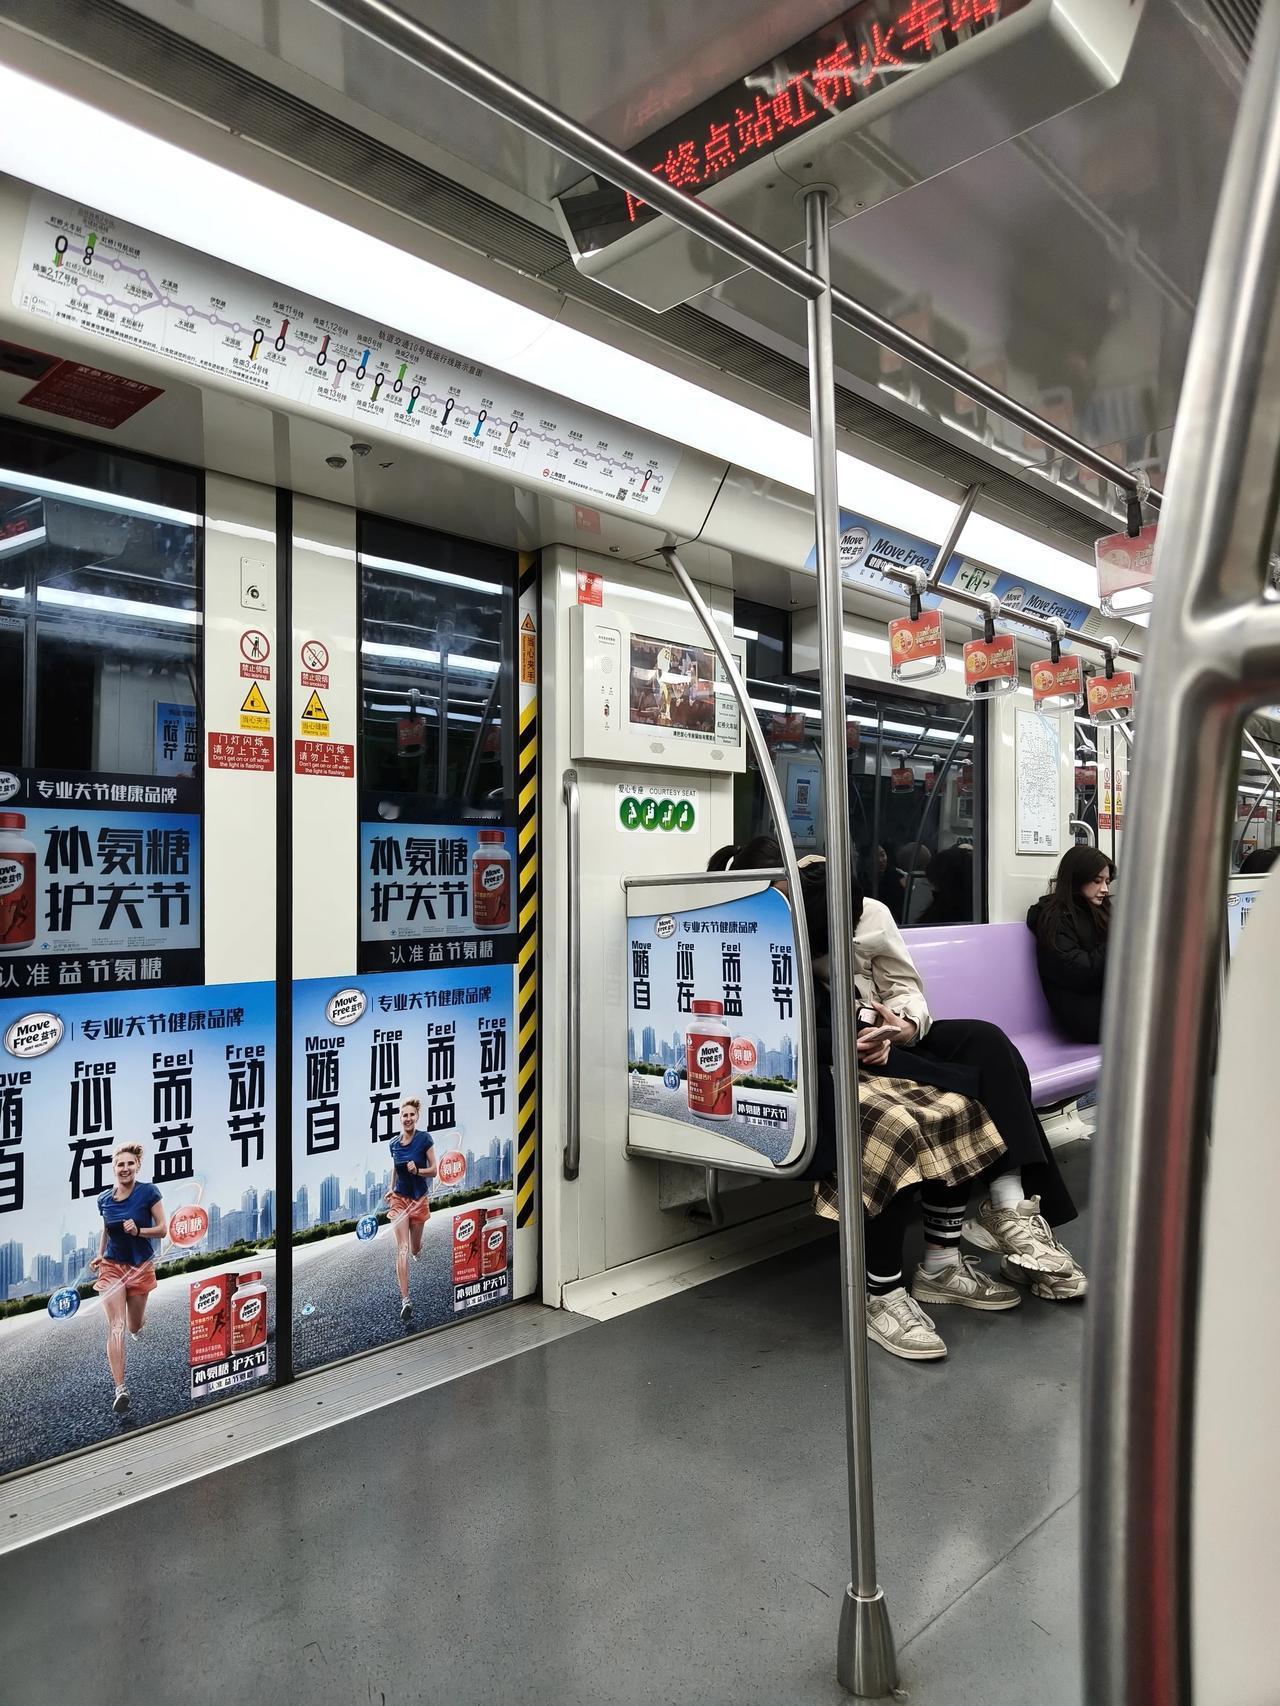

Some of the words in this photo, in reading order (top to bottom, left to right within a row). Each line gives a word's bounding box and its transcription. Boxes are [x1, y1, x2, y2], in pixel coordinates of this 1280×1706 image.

[625, 0, 998, 222] 终点站虹桥火车站
[124, 283, 154, 299] 上海动物园
[272, 301, 304, 319] 换乘11号线
[317, 386, 347, 401] 换乘13号线
[356, 399, 385, 415] 换乘14号线
[394, 412, 421, 426] 换乘12号线
[841, 535, 864, 545] Move
[872, 538, 906, 559] Move
[903, 549, 930, 568] Free
[1026, 595, 1048, 611] Move
[1048, 602, 1067, 616] Free
[218, 734, 264, 746] 门灯闪烁
[213, 745, 270, 756] 请勿上下车
[304, 742, 346, 754] 门灯闪烁
[299, 752, 350, 764] 请勿上下车
[328, 769, 345, 777] flashing
[36, 779, 178, 805] 专业关节健康品牌
[618, 784, 643, 794] 爱心专座
[649, 787, 680, 796] COURTESY
[681, 789, 696, 797] SEAT
[44, 825, 191, 876] 补氨糖
[370, 836, 468, 876] 补氨糖
[0, 865, 17, 876] ove
[485, 868, 501, 877] Move
[44, 881, 191, 932] 护关节
[370, 881, 469, 922] 护关节
[682, 921, 759, 934] 专业关节健康品牌
[631, 940, 652, 950] Move
[677, 941, 695, 951] Free
[721, 942, 741, 952] Feel
[769, 943, 792, 954] Free
[335, 995, 358, 1008] Move
[378, 986, 492, 1013] 专业关节健康品牌
[332, 1006, 350, 1018] Free
[17, 1020, 50, 1037] Move
[81, 1007, 245, 1041] 专业关节健康品牌
[13, 1033, 39, 1049] Free
[41, 1028, 57, 1041] 益节
[305, 1036, 345, 1051] Move
[374, 1029, 403, 1043] Free
[427, 1020, 456, 1036] Feel
[478, 1017, 506, 1030] Free
[701, 1047, 719, 1055] Move
[0, 1070, 32, 1087] ove
[74, 1061, 117, 1078] Free
[152, 1049, 194, 1069] Feel
[225, 1044, 265, 1061] Free
[699, 1055, 714, 1065] Free
[762, 1107, 786, 1119] 护关节
[175, 1217, 202, 1235] 氨糖
[199, 1289, 216, 1300] Move
[197, 1298, 211, 1310] Free
[243, 1301, 257, 1310] Move
[232, 1350, 265, 1372] 护关节
